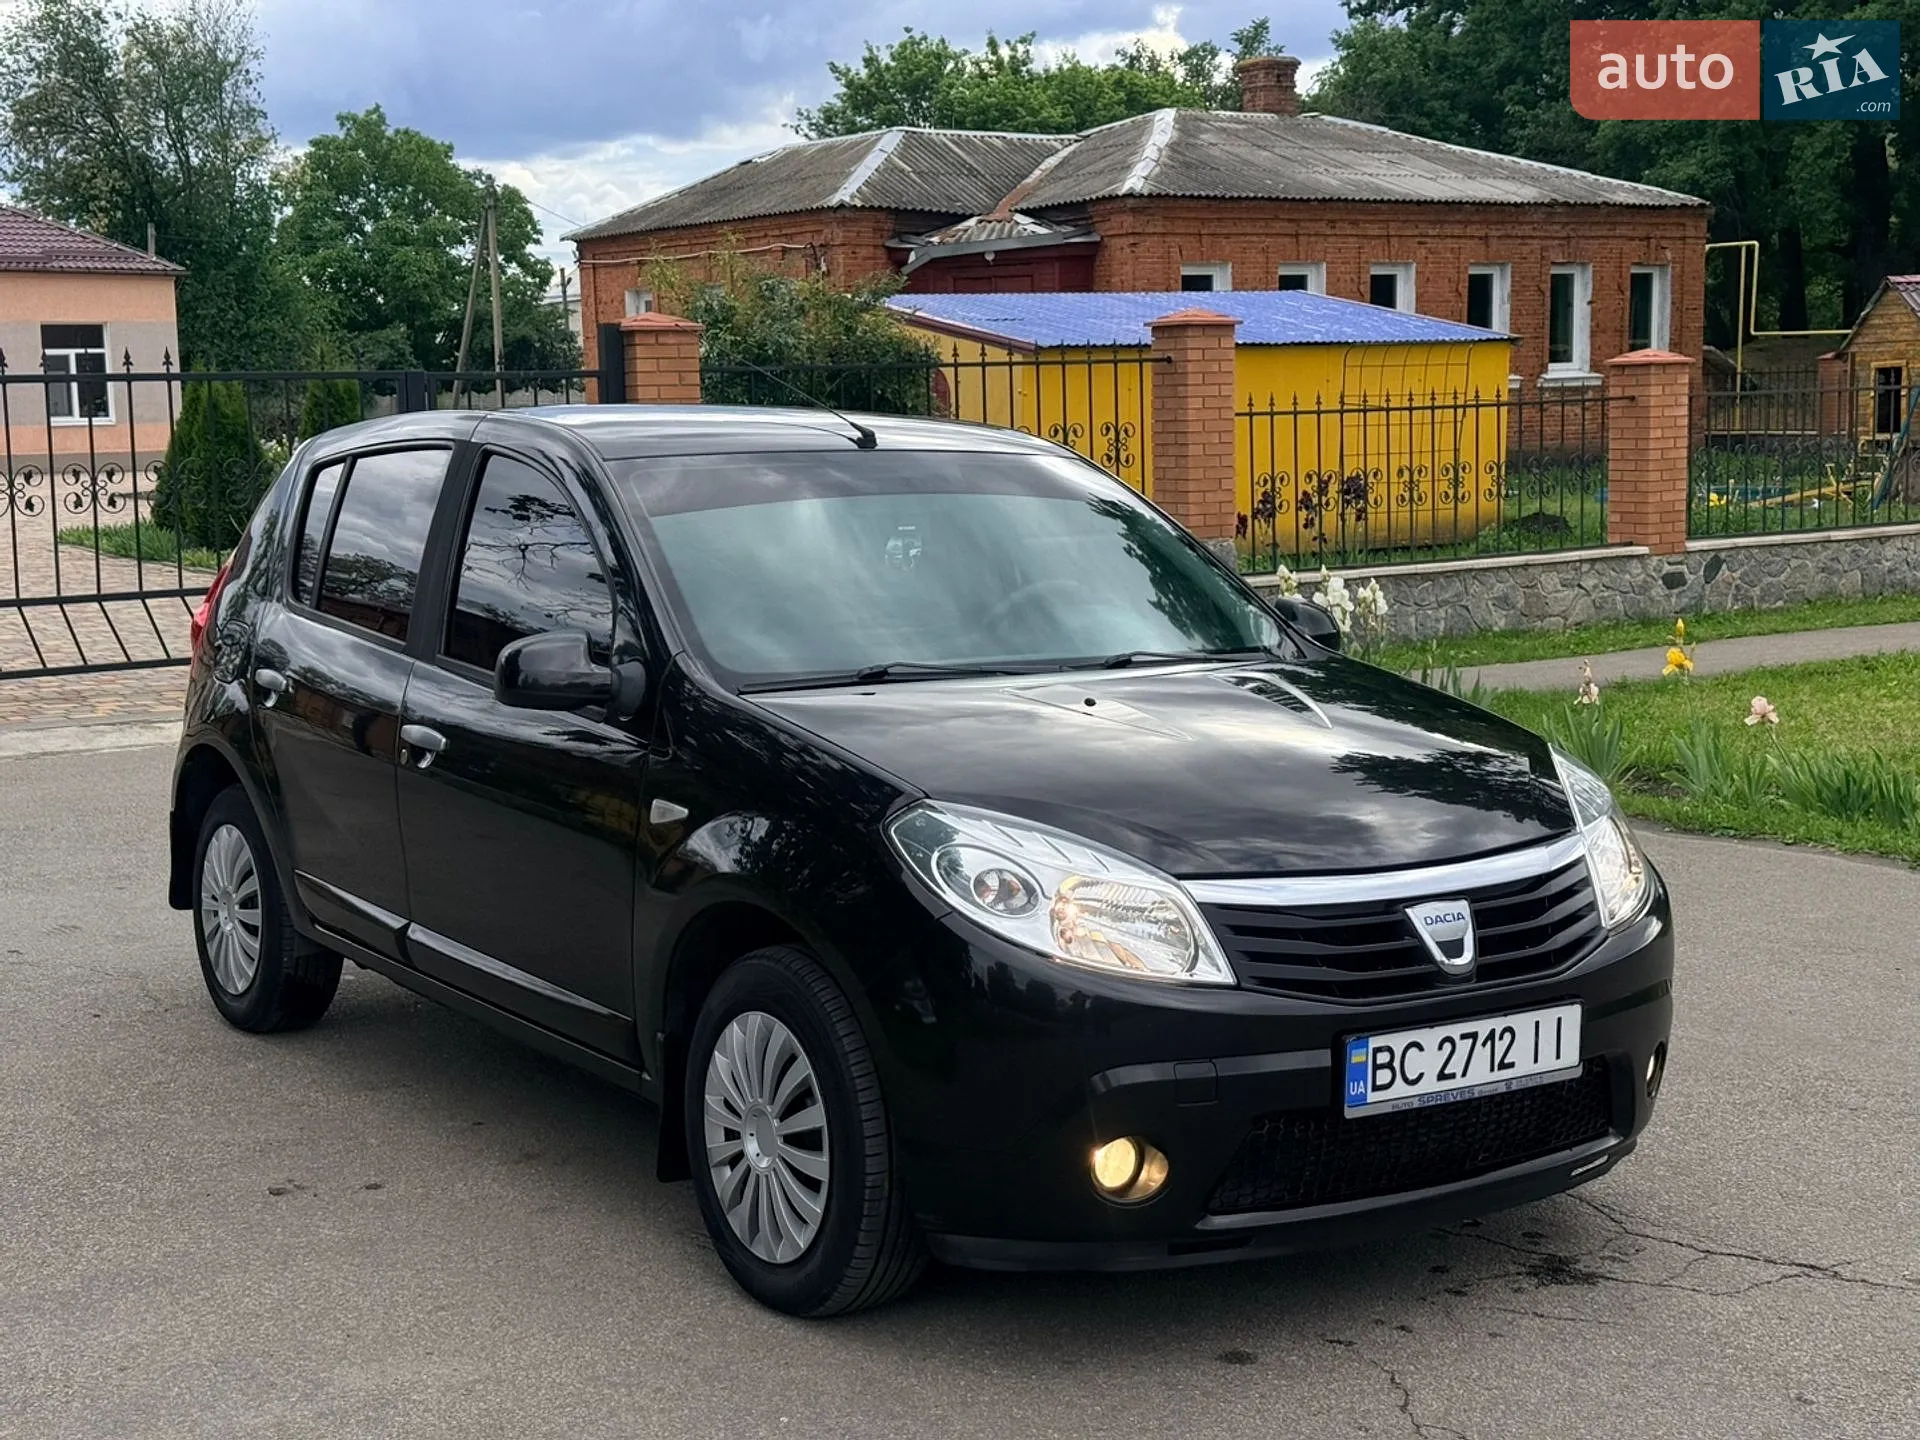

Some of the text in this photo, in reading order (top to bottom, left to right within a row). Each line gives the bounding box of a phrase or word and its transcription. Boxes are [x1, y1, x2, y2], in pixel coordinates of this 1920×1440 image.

[1423, 911, 1466, 926] DACIA
[1371, 1040, 1425, 1092] BC
[1436, 1025, 1516, 1082] 2712
[1349, 1080, 1366, 1096] UA
